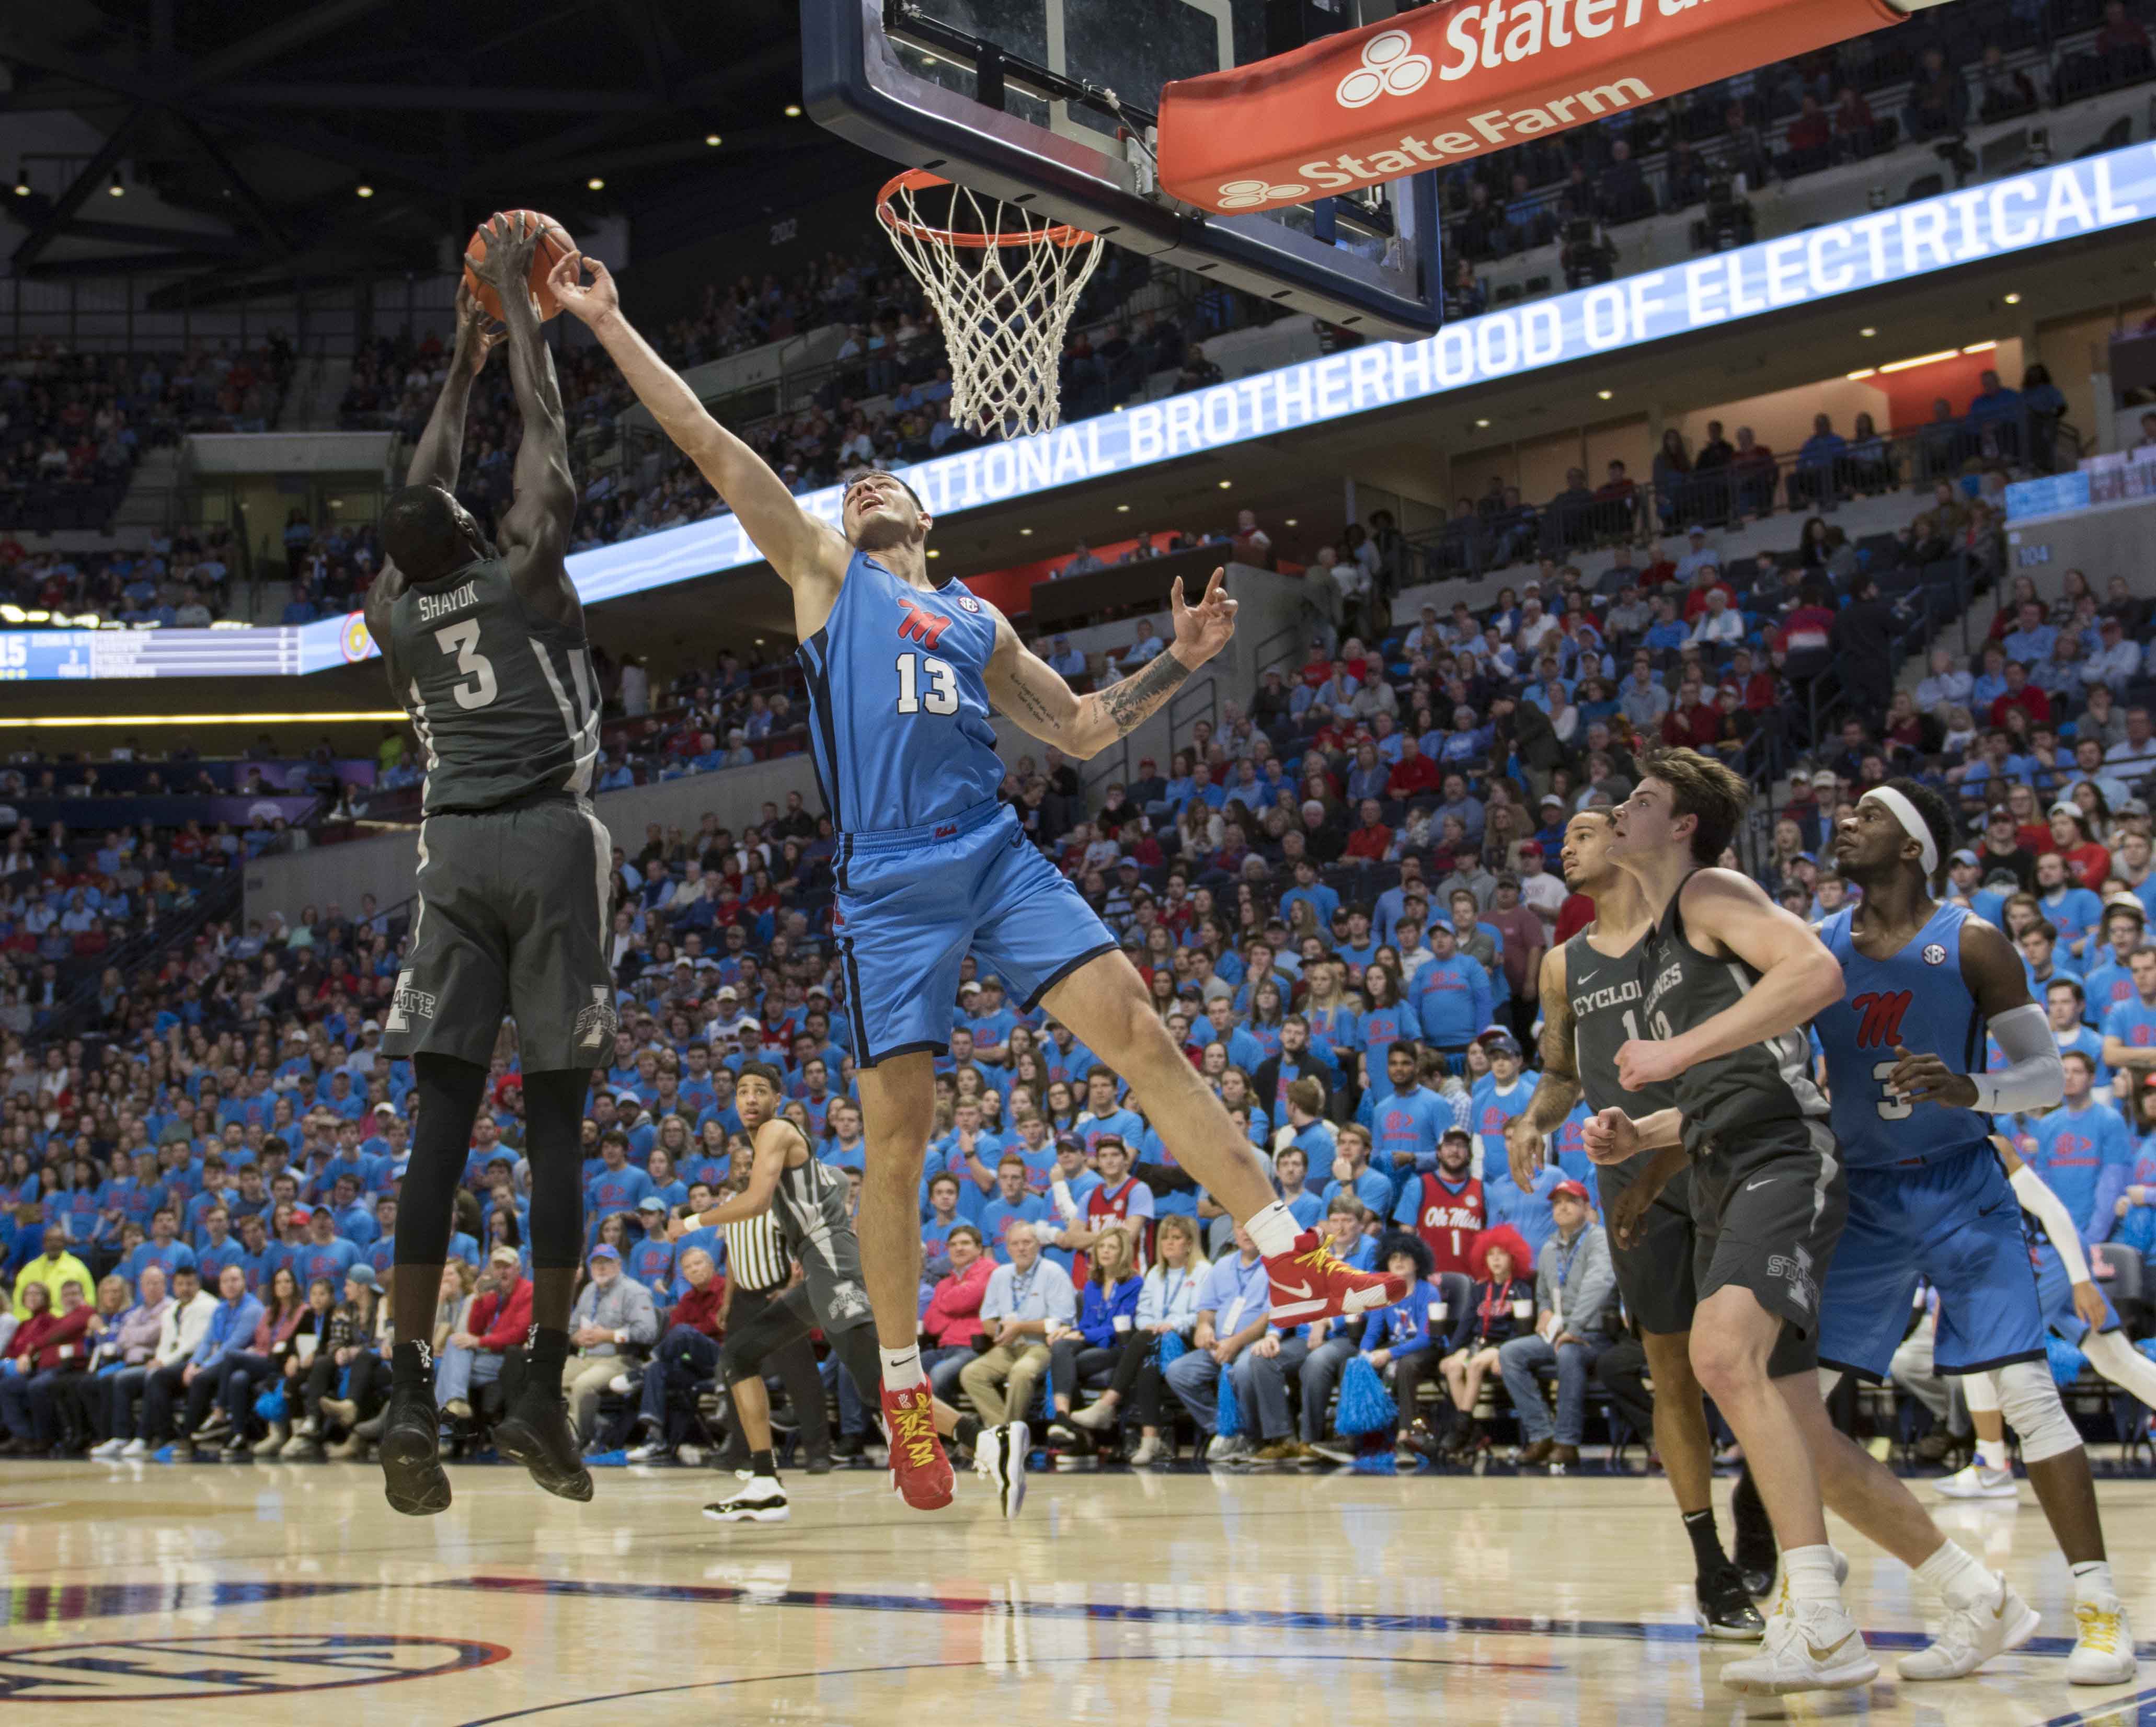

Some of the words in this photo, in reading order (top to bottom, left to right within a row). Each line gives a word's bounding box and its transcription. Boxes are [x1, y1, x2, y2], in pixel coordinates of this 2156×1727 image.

[1297, 76, 1653, 188] StateFarm
[1128, 309, 1562, 466] BROTHERHOOD
[1583, 275, 1666, 342] OF
[1685, 156, 2138, 325] ELECTRICAL
[418, 580, 479, 621] SHAYOK
[958, 597, 979, 613] SEC
[434, 618, 498, 709] 3
[896, 652, 959, 715] 13
[1923, 945, 1946, 965] SEC
[1872, 1061, 1913, 1121] 3
[1425, 1206, 1448, 1227] Ole
[1449, 1207, 1481, 1230] Miss
[1451, 1229, 1461, 1256] 1
